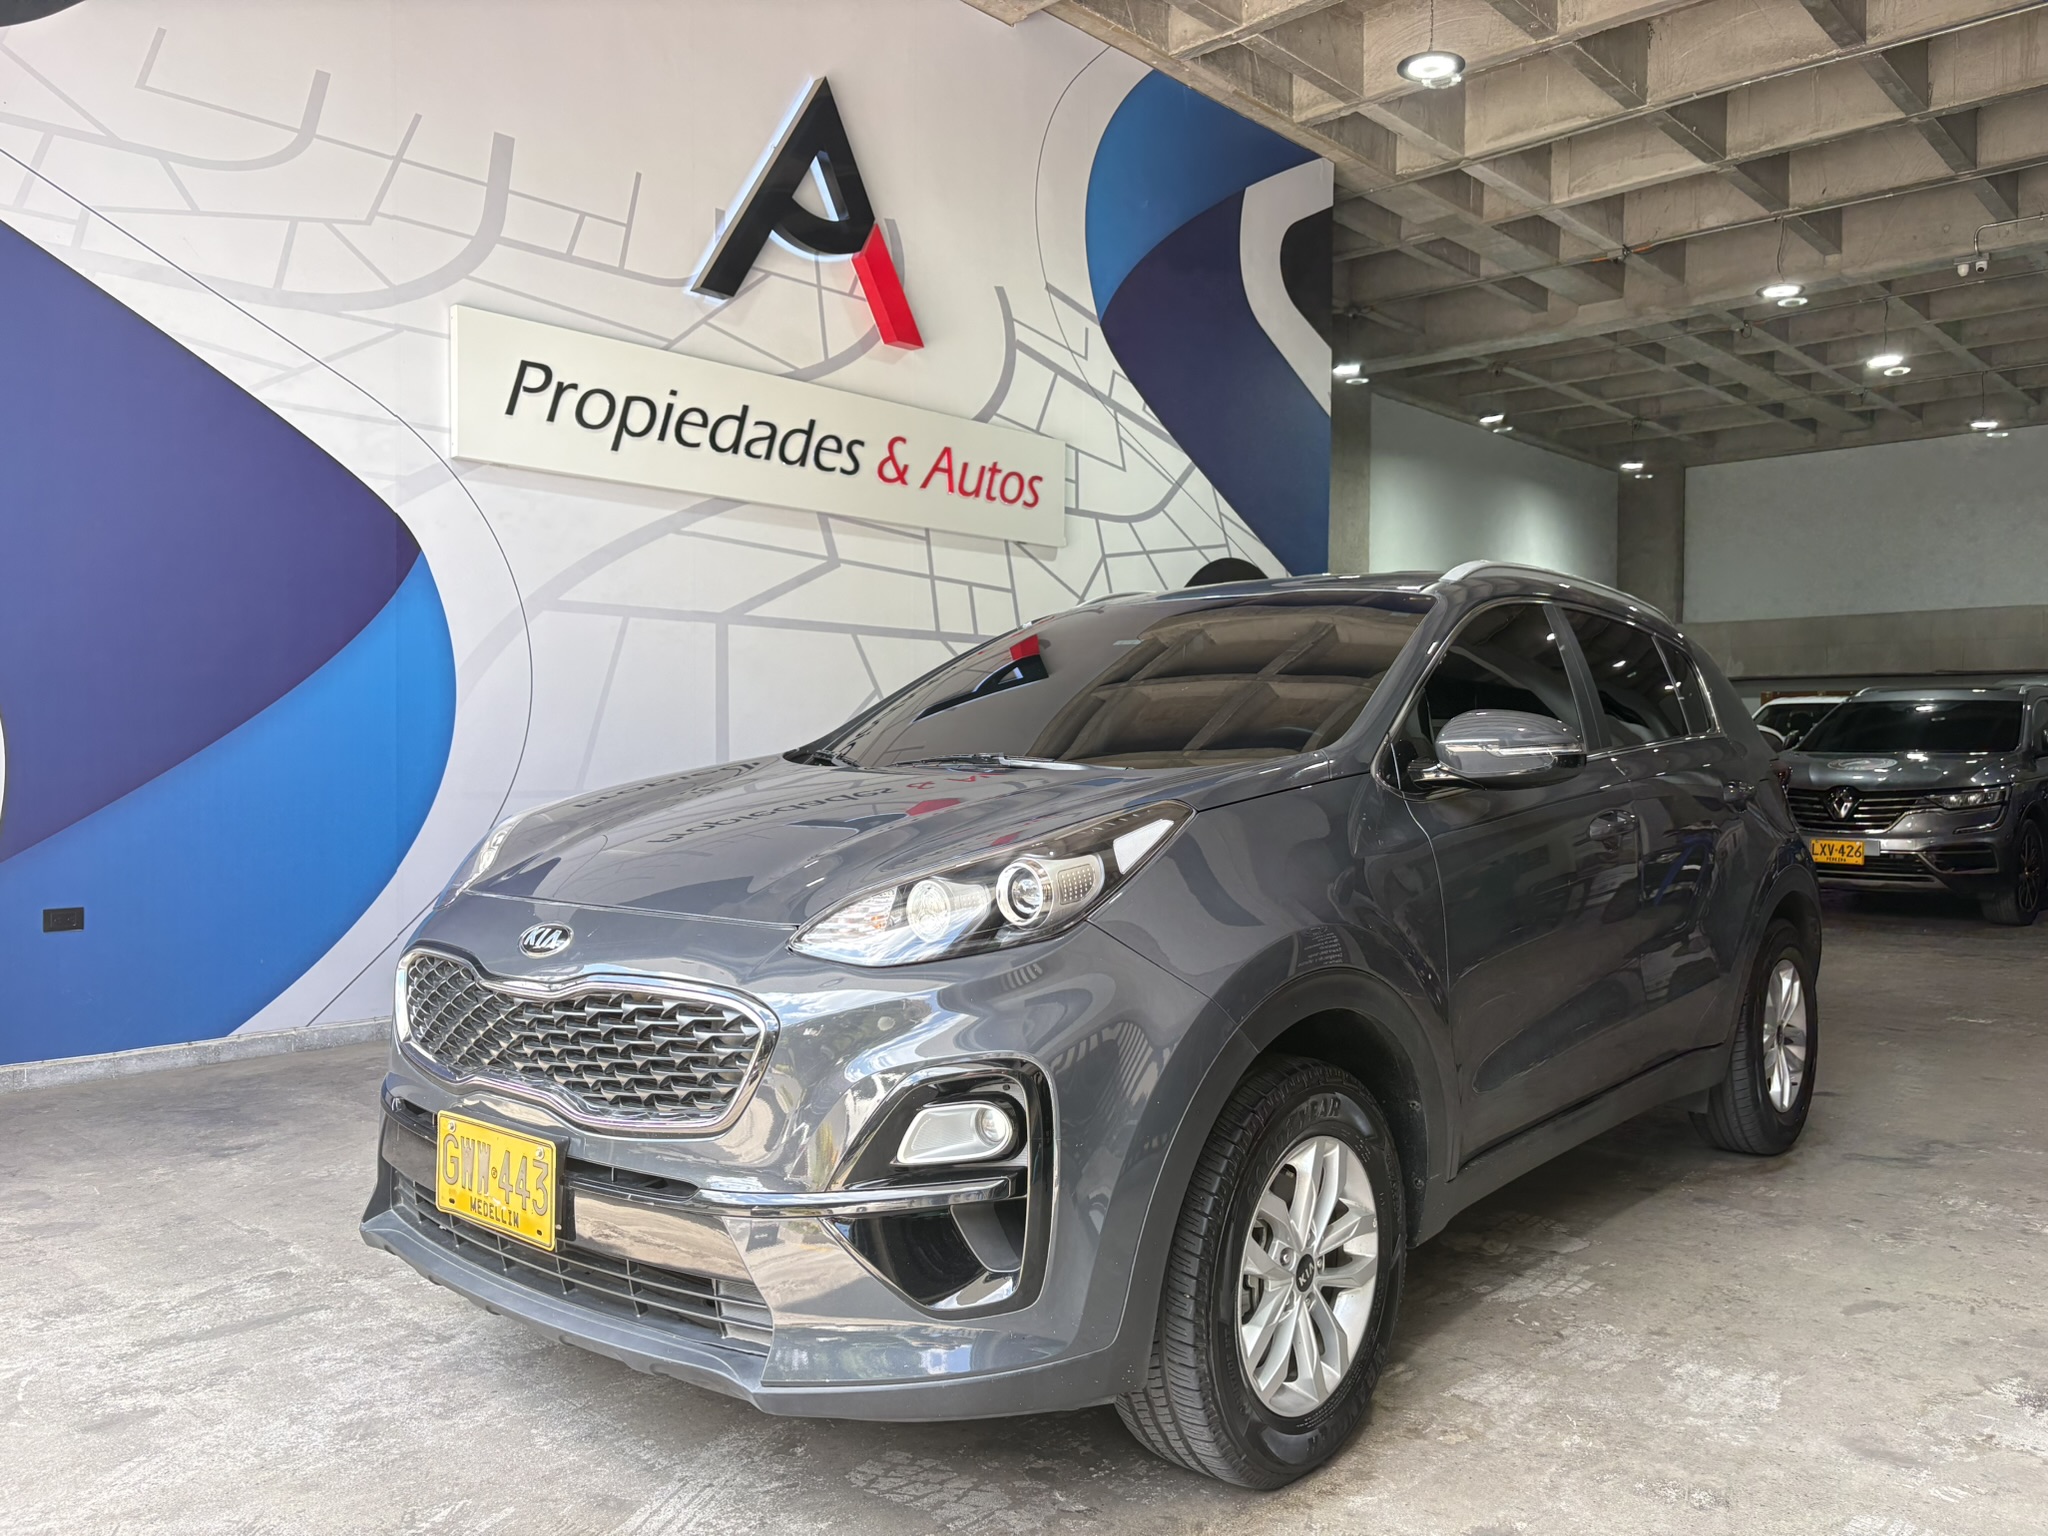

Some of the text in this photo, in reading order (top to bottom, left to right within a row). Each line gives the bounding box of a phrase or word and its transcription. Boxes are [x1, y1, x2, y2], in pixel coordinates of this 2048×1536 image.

[504, 359, 1043, 509] Propiedades & Autos
[523, 927, 563, 950] KIA
[469, 1196, 520, 1229] MEDELLIN
[1298, 1262, 1315, 1287] KIA
